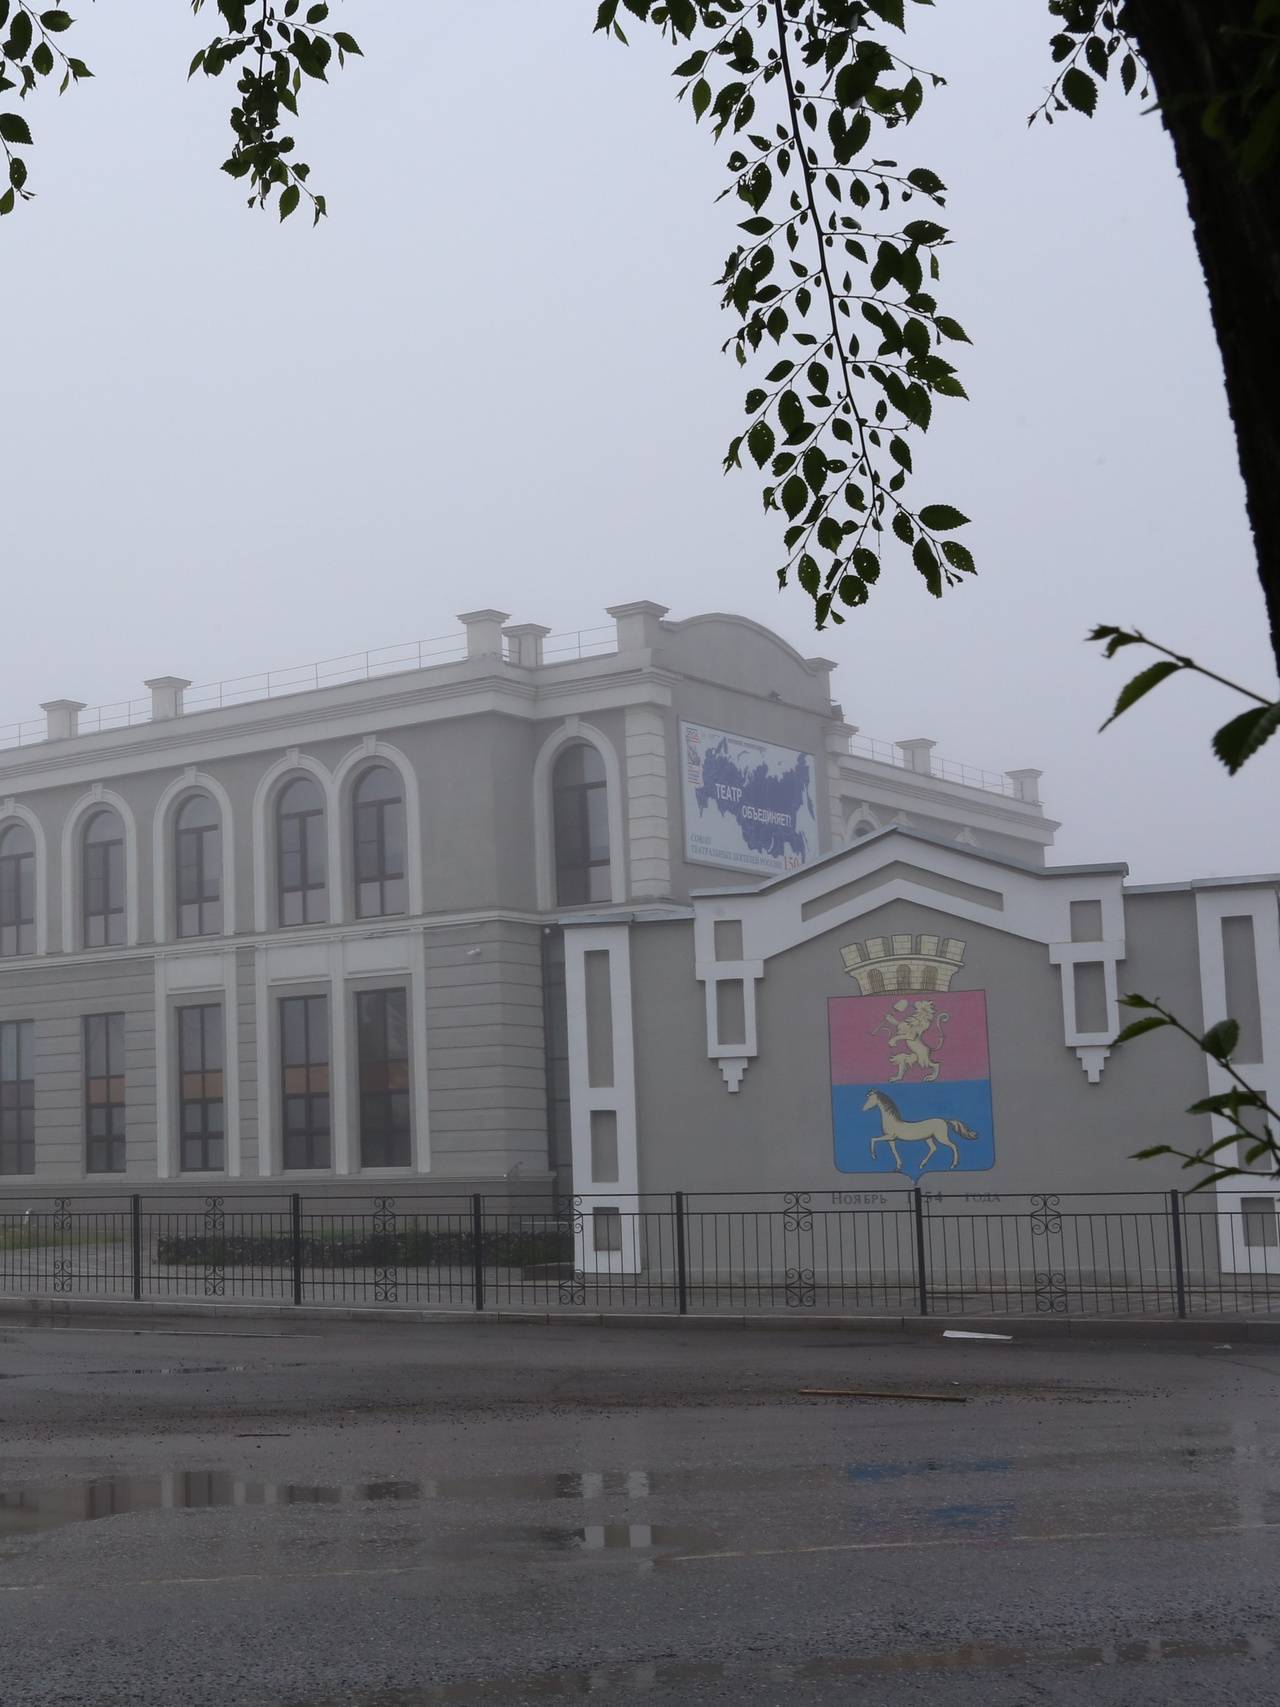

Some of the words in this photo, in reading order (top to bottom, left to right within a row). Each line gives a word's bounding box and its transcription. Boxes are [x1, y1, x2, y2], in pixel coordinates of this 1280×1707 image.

[716, 783, 742, 802] ТЕАТР
[742, 805, 792, 827] ОБЪЕДИНЯЕТ!
[691, 845, 732, 859] ТЕАТРАЛЬНЫХ
[906, 1191, 943, 1204] 154
